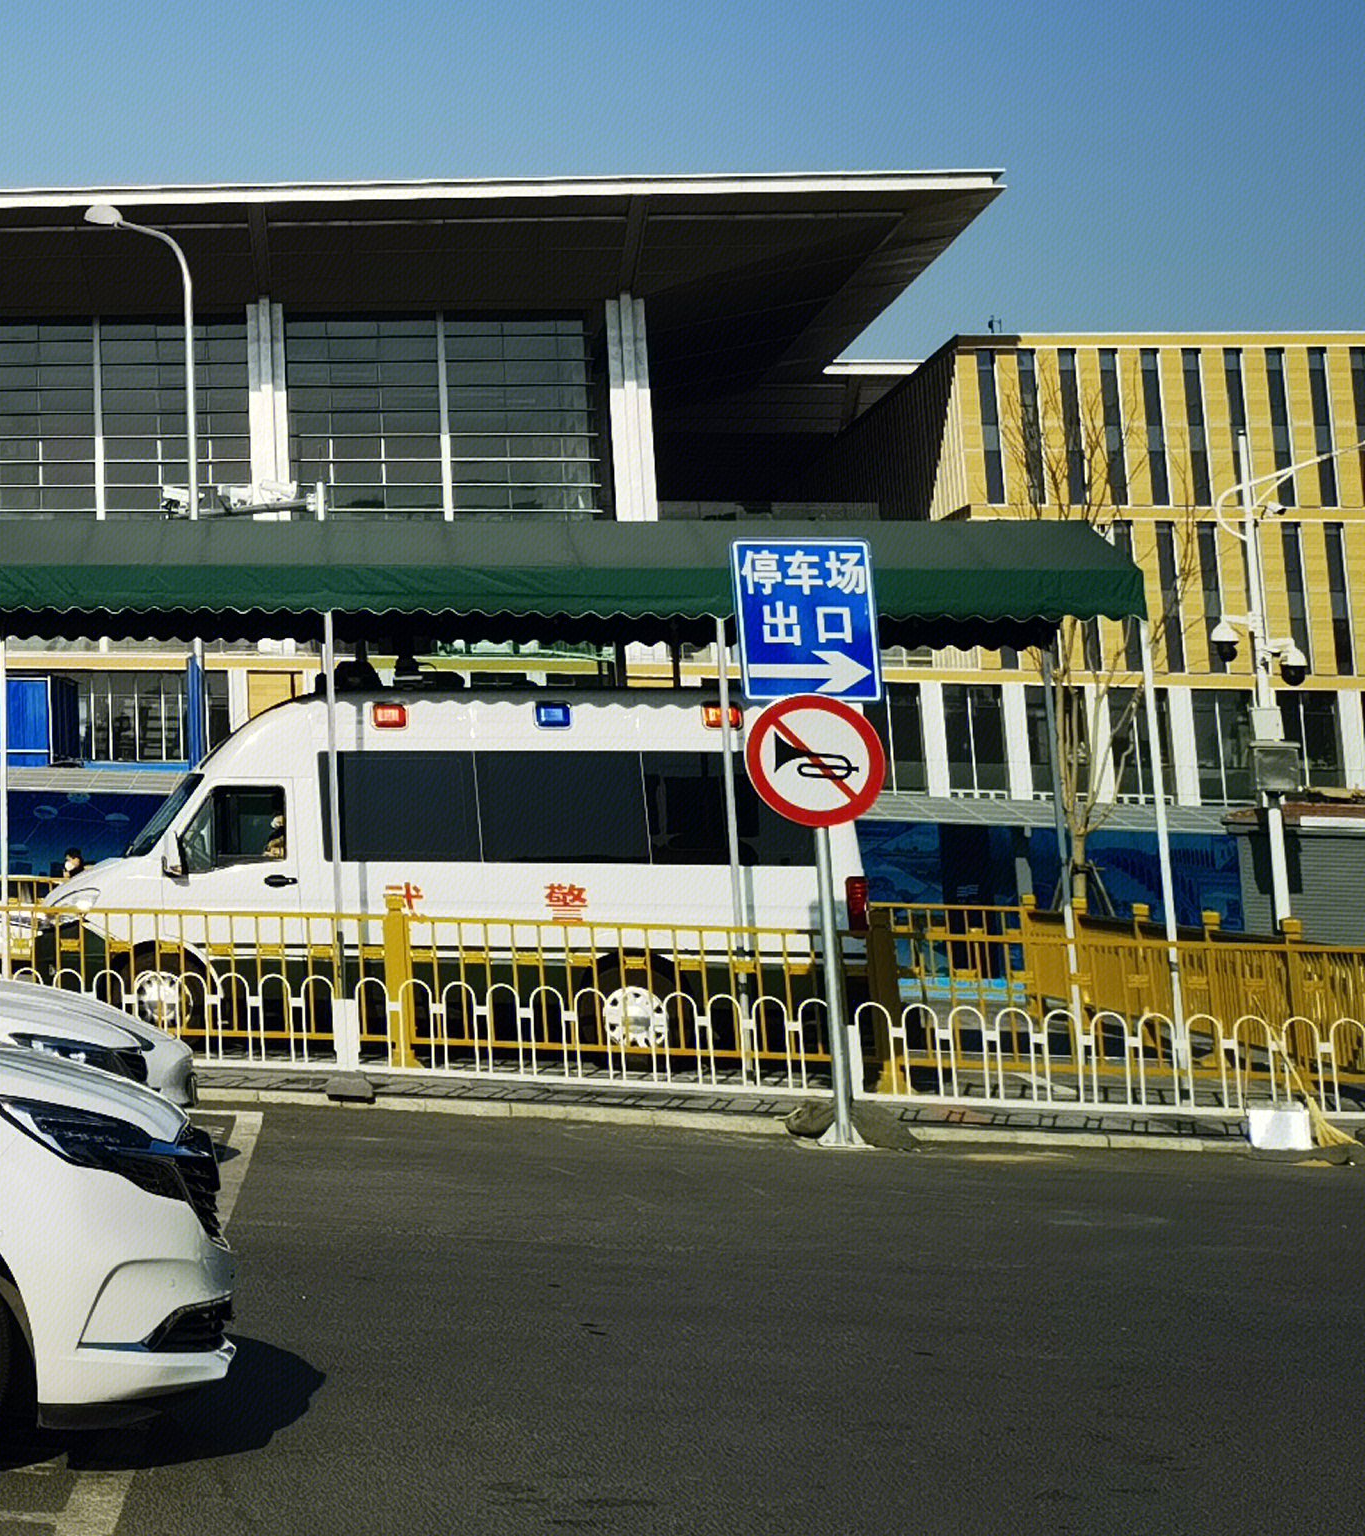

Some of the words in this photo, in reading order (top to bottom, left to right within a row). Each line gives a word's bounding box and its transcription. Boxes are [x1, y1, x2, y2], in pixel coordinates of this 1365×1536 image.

[740, 549, 867, 596] 停车场
[762, 600, 853, 646] 出口
